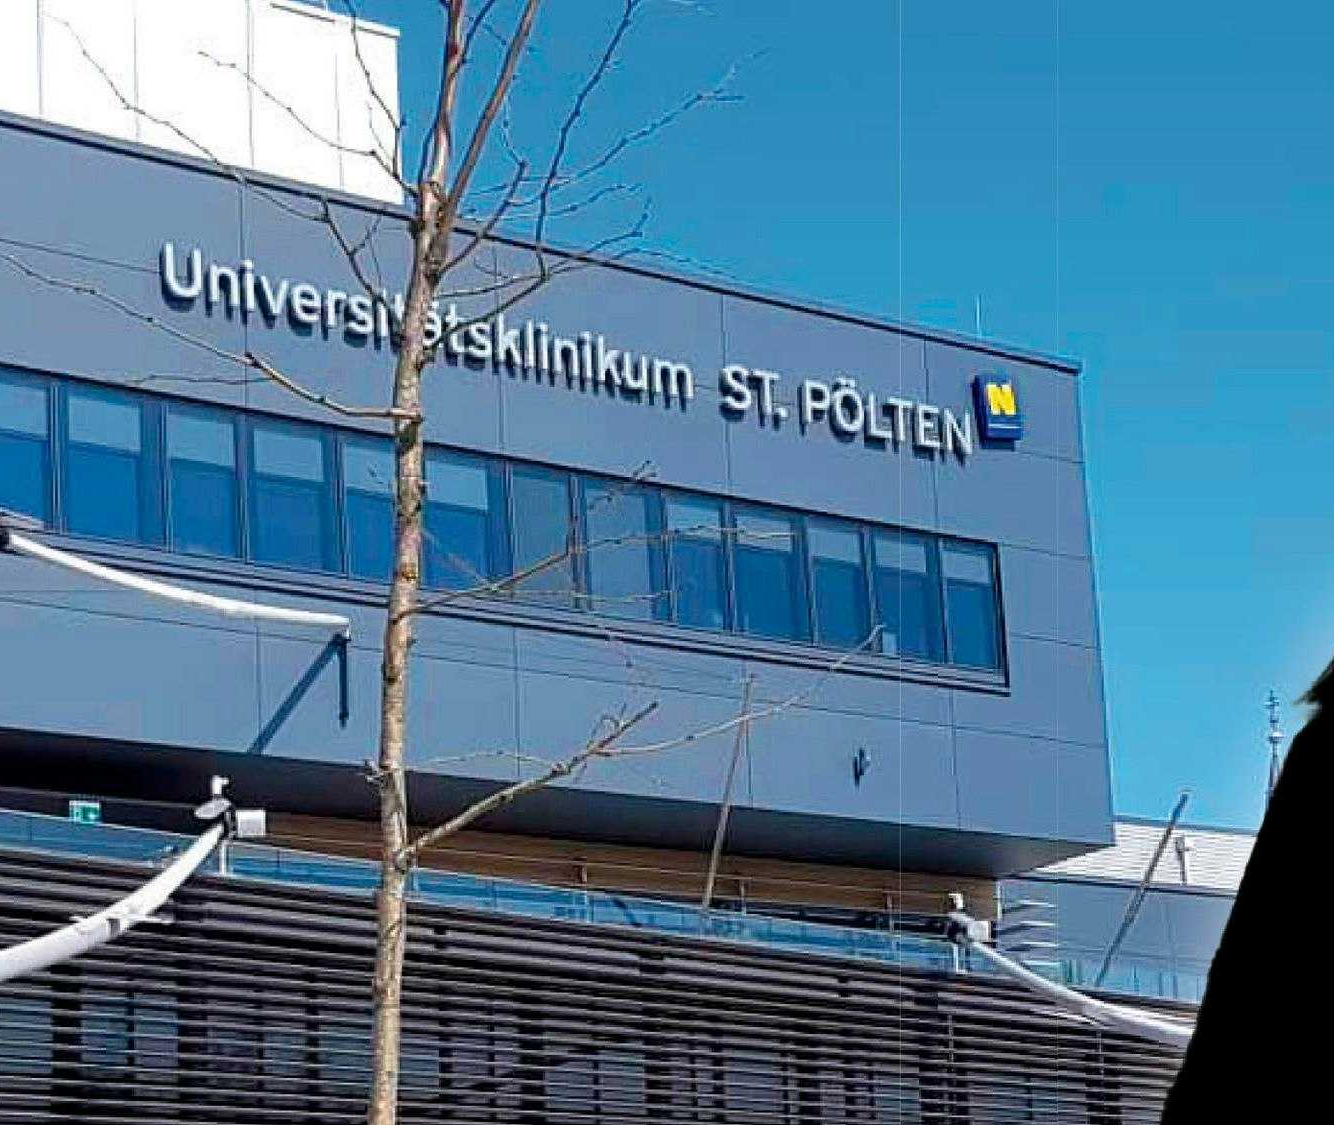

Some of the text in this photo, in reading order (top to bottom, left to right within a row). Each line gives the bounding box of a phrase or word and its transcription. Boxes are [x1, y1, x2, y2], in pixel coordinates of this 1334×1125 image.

[722, 365, 789, 419] ST.
[803, 377, 972, 454] PÖLTEN
[986, 383, 1017, 416] N
